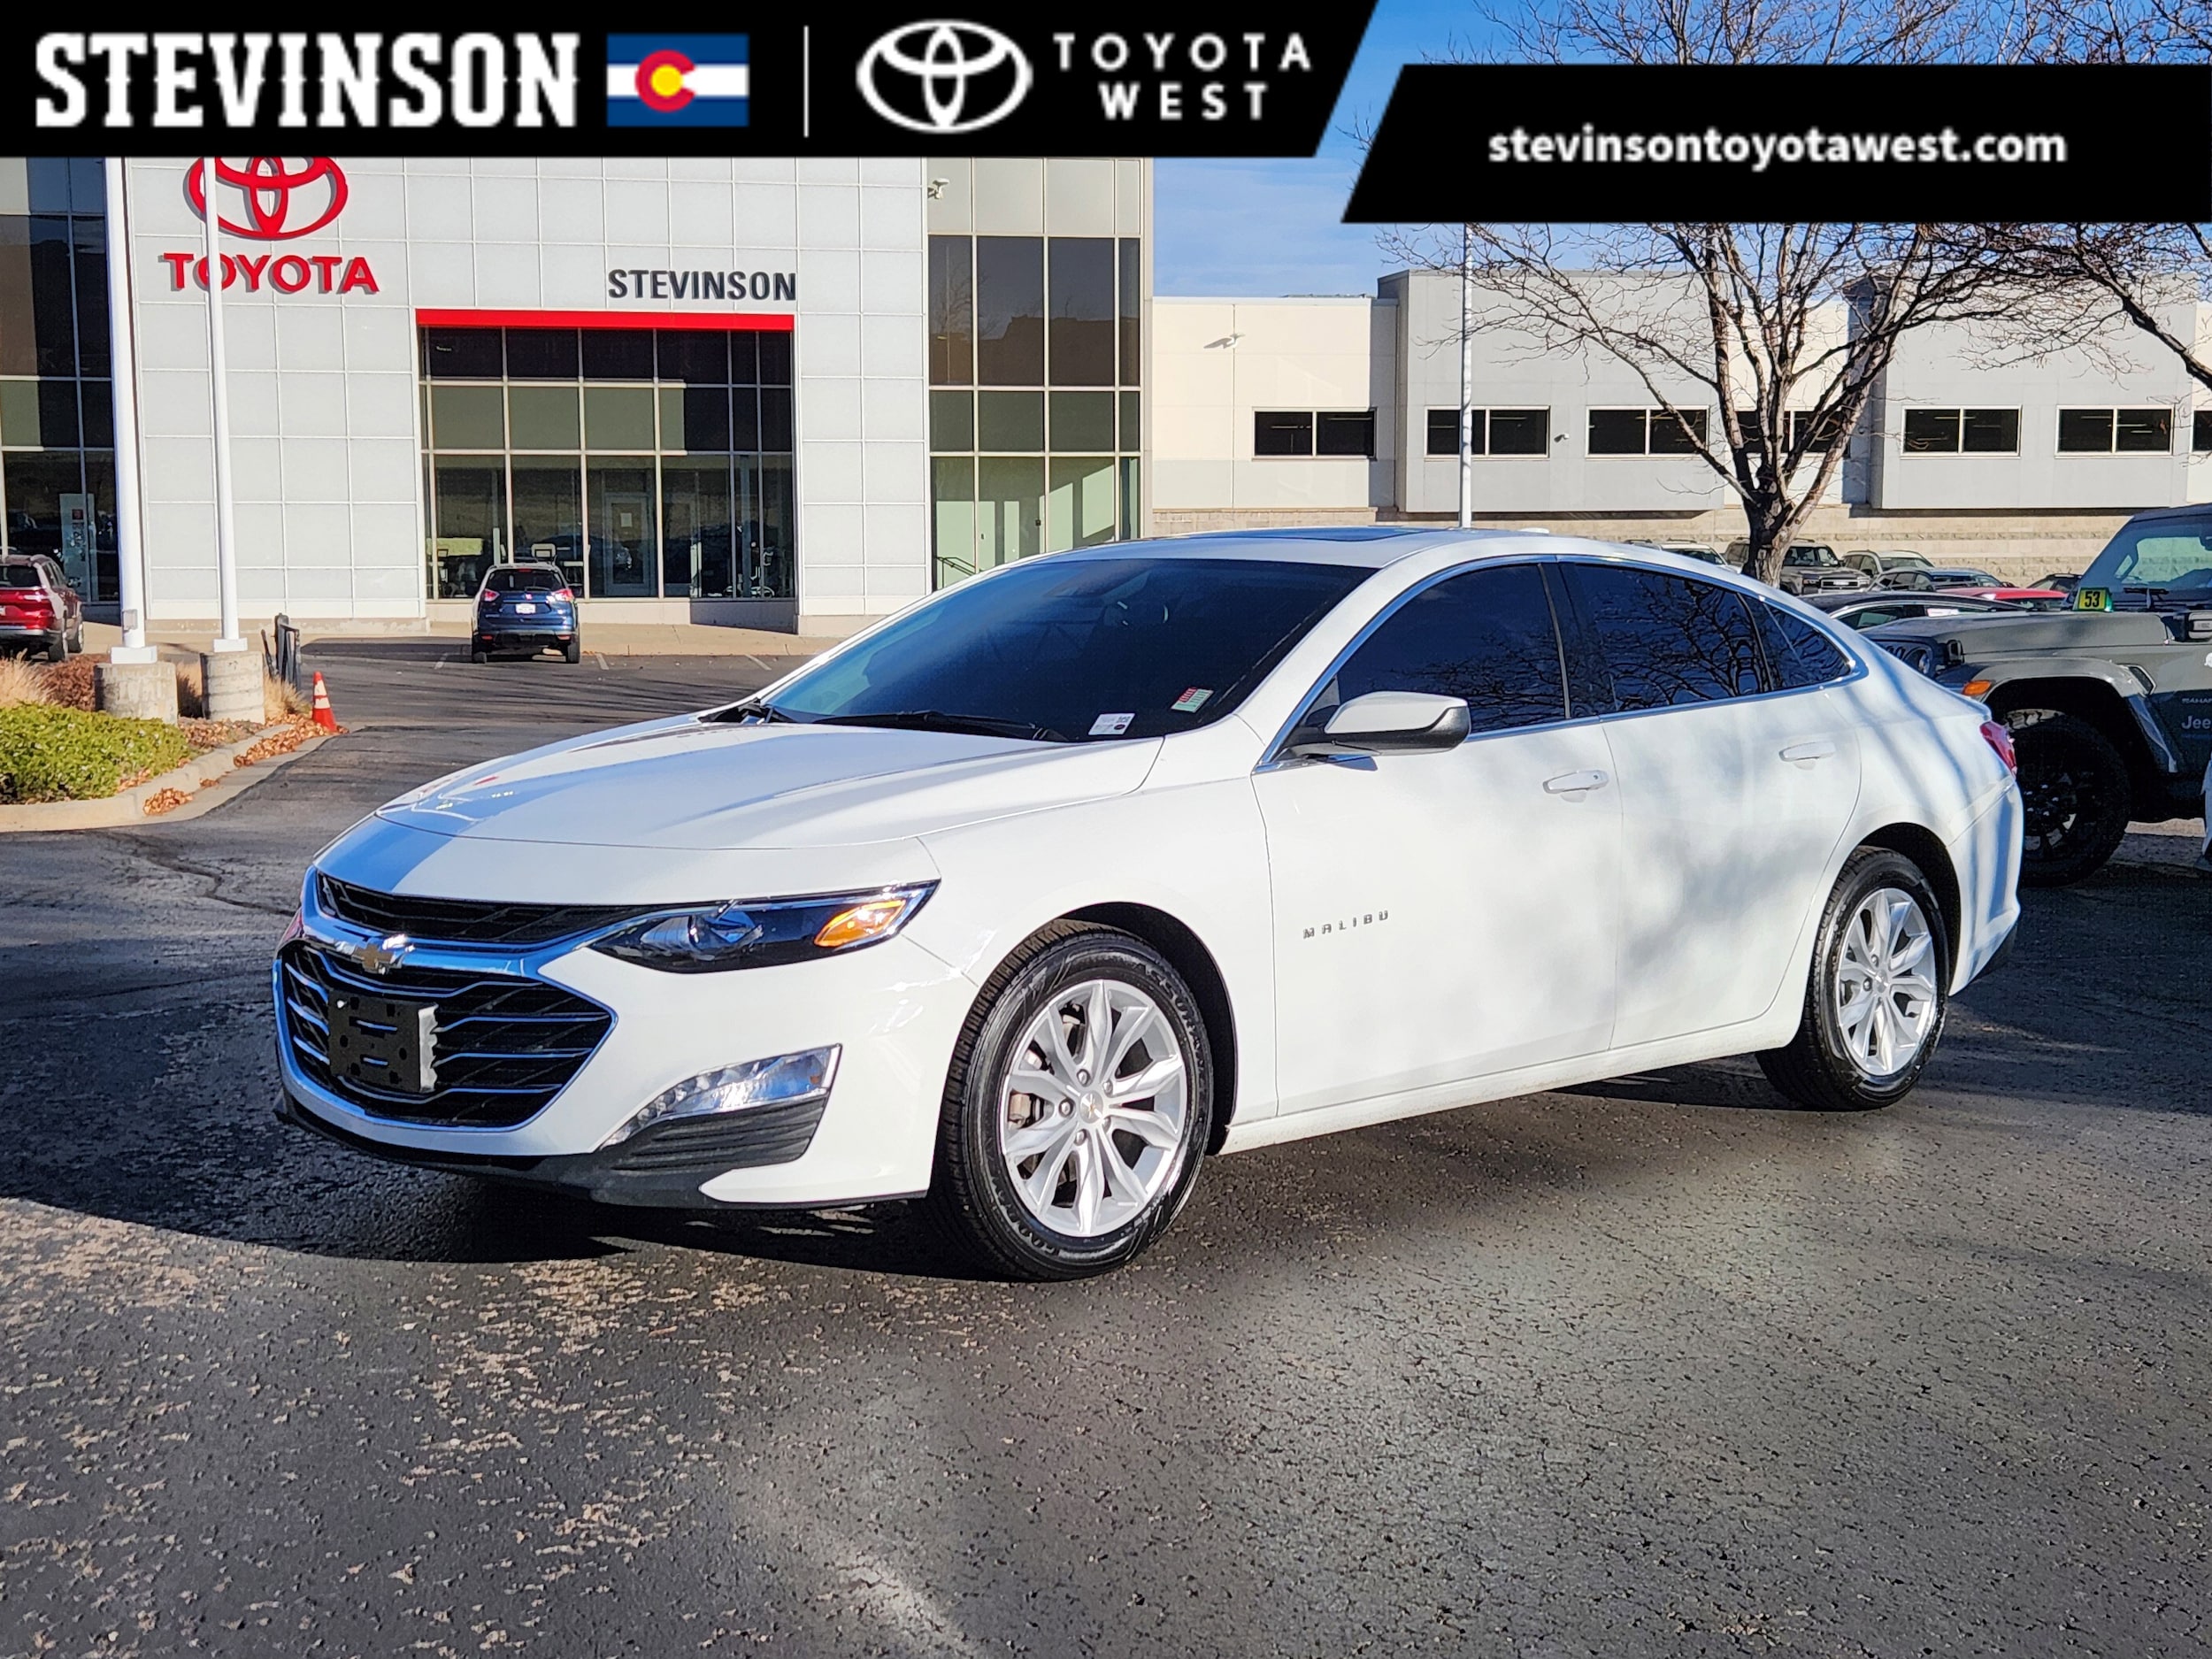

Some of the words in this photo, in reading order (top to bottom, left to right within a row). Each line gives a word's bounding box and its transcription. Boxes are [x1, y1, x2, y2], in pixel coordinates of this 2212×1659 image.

[160, 251, 380, 295] TOYOTA
[607, 268, 797, 302] STEVINSON
[2084, 590, 2101, 608] 53
[2181, 715, 2212, 730] Jee
[1302, 910, 1389, 940] MALIBU
